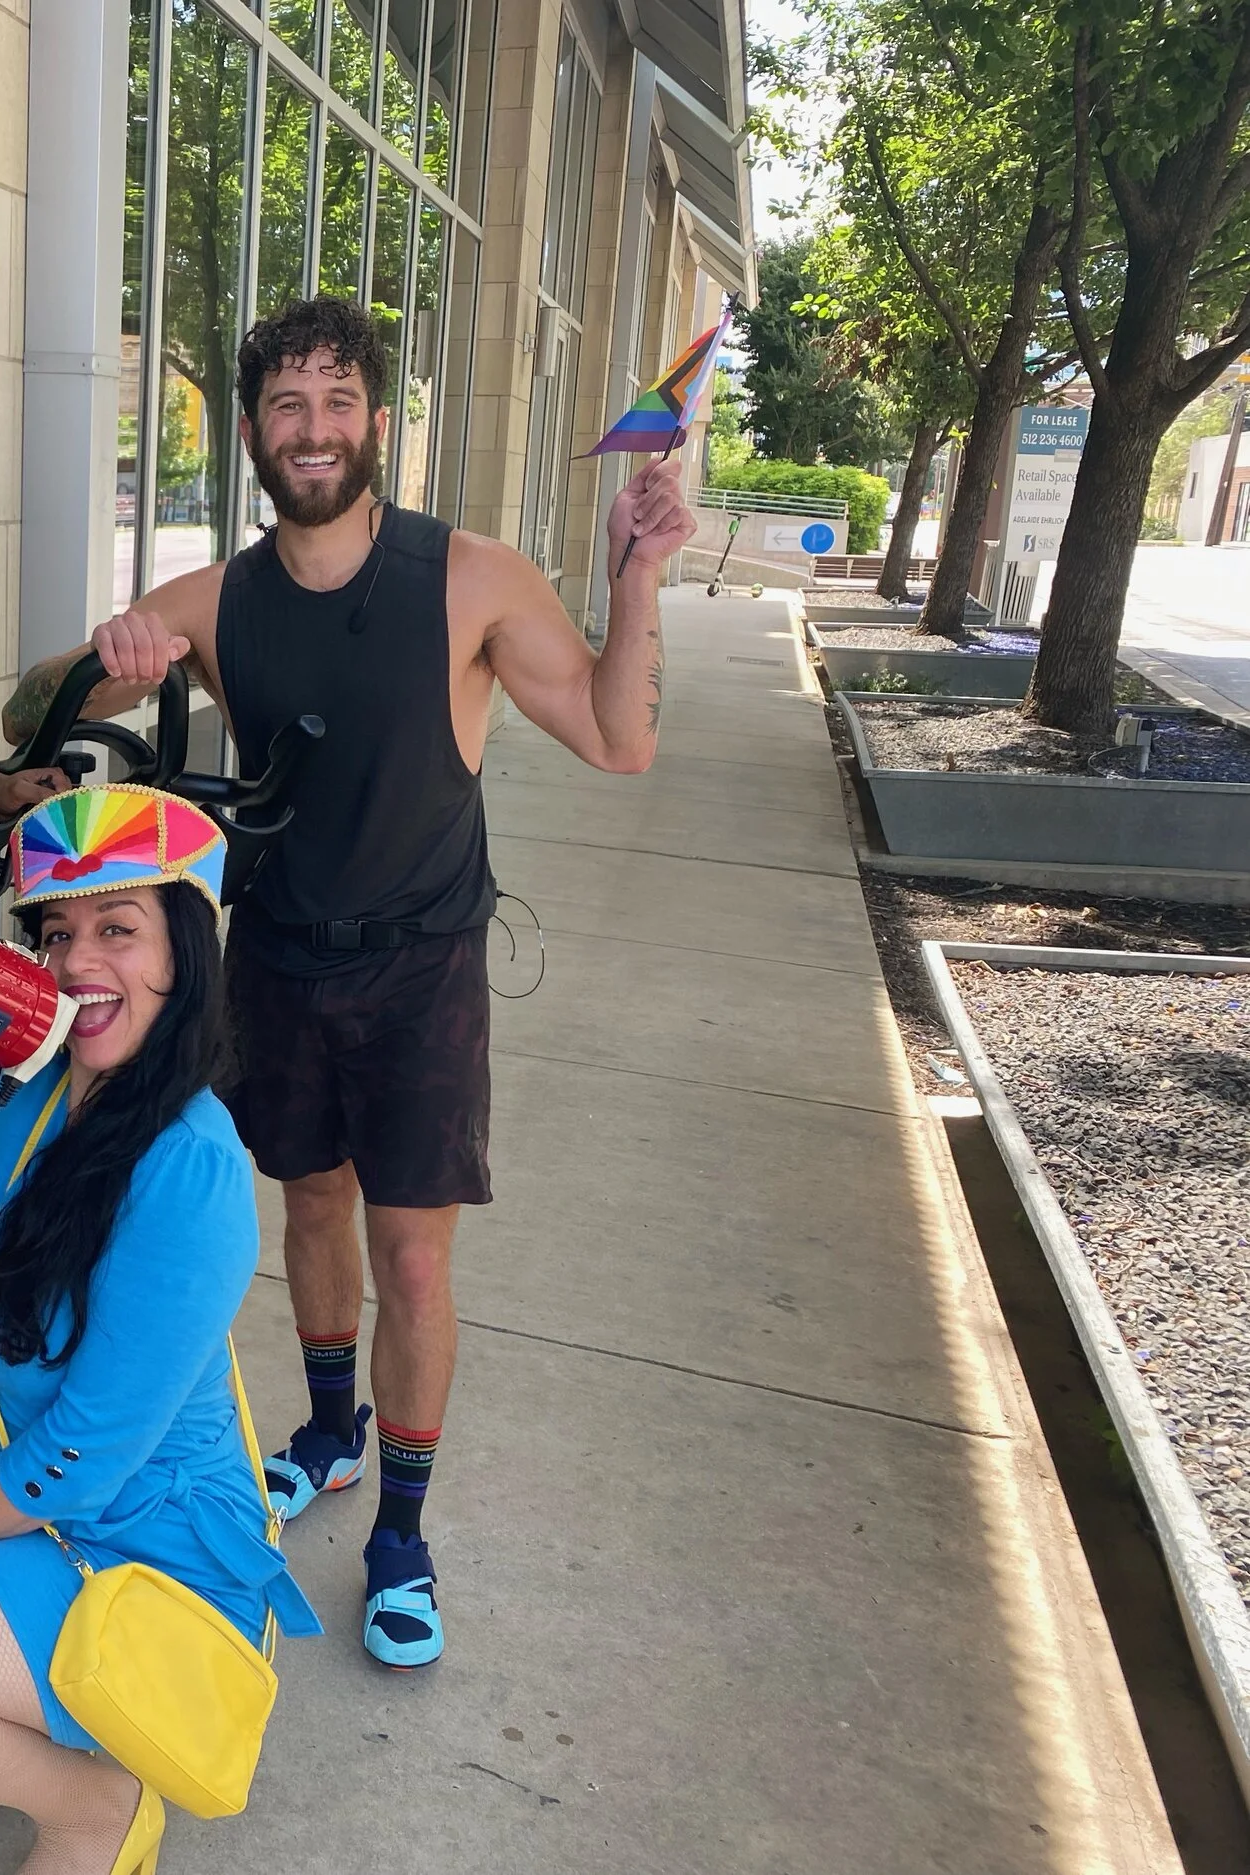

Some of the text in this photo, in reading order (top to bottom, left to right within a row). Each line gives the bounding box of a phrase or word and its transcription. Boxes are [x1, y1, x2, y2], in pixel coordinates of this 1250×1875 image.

[1031, 414, 1078, 427] FOR LEASE
[1021, 433, 1083, 447] 512 236 4600
[1018, 469, 1077, 485] Retail Space
[1016, 488, 1061, 501] Available
[1013, 515, 1040, 524] ADELAIDE
[304, 1347, 345, 1358] LEMON
